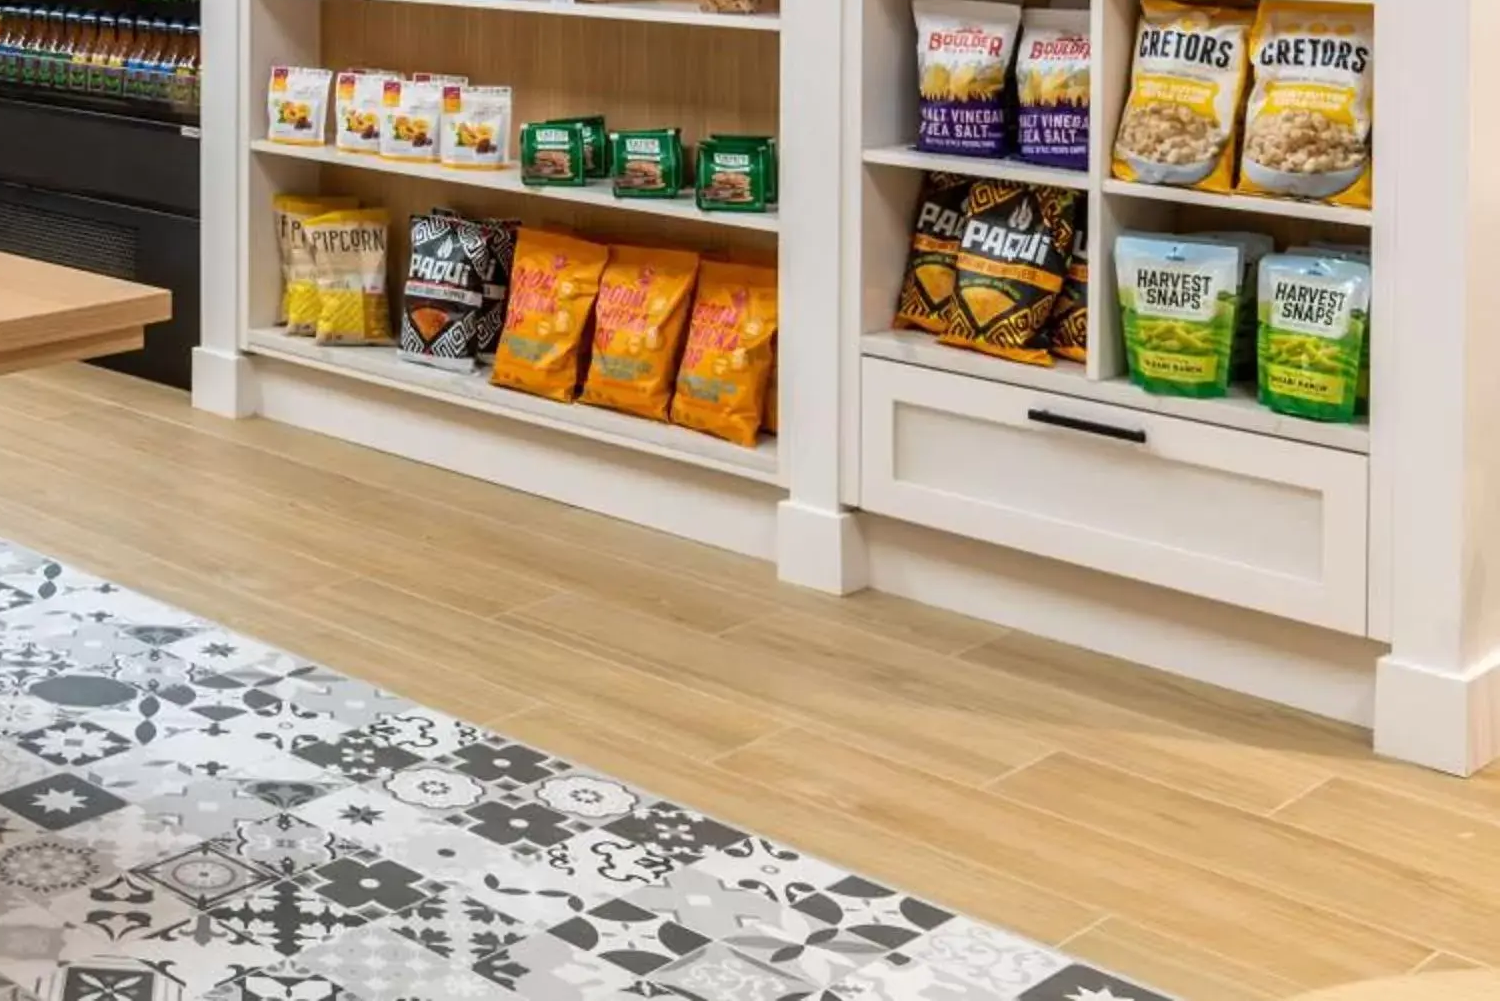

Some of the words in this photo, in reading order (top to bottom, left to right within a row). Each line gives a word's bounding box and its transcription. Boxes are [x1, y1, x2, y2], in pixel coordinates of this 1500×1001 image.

[928, 32, 1004, 58] BOULDER
[1139, 29, 1234, 69] CRETORS
[1259, 37, 1370, 74] CRETORS
[955, 124, 989, 138] SALT
[1043, 129, 1075, 144] SALT
[311, 229, 385, 254] PIPCORN
[1137, 269, 1213, 296] HARVEST
[1146, 288, 1201, 310] SNAPS
[1275, 282, 1347, 312] HARVEST
[1281, 302, 1334, 327] SNAPS
